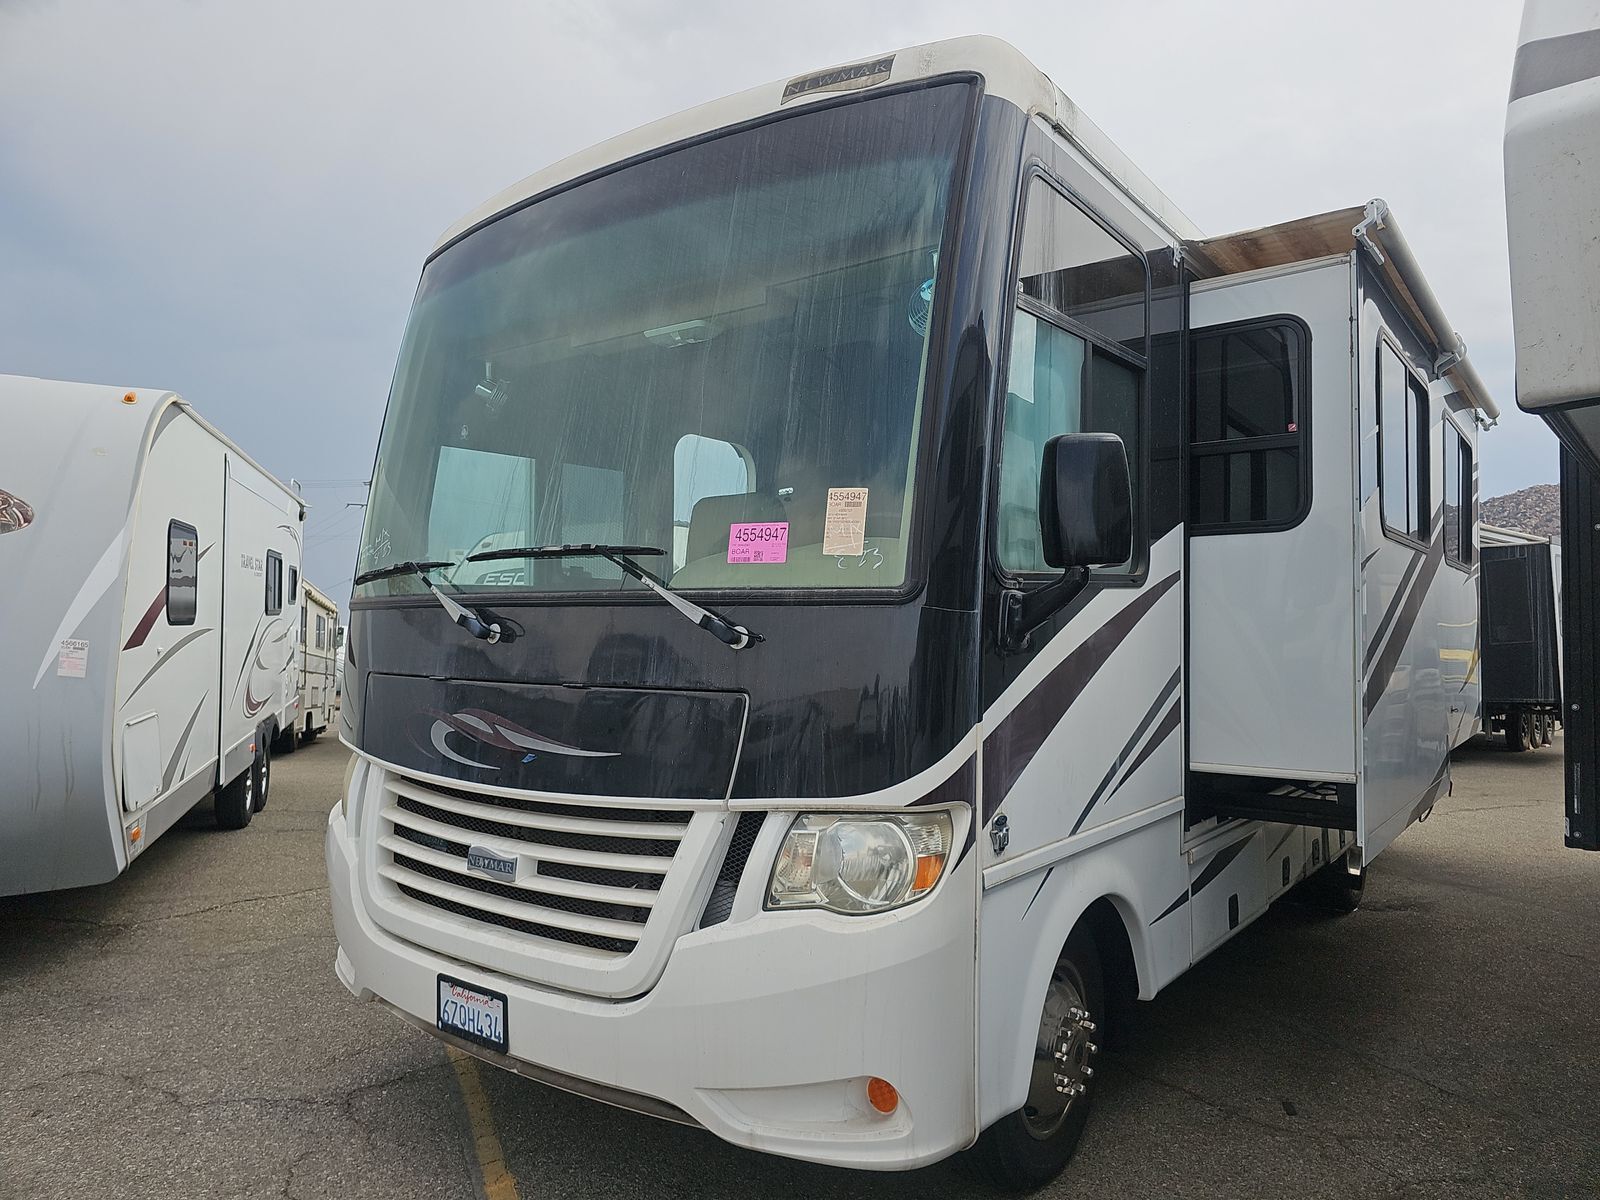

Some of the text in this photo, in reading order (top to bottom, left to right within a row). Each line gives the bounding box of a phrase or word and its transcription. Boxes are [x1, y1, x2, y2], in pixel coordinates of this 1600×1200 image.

[786, 62, 888, 95] NEWMAR
[829, 491, 867, 501] 4554947
[735, 527, 787, 542] 4554947
[469, 855, 513, 873] NEWMAR
